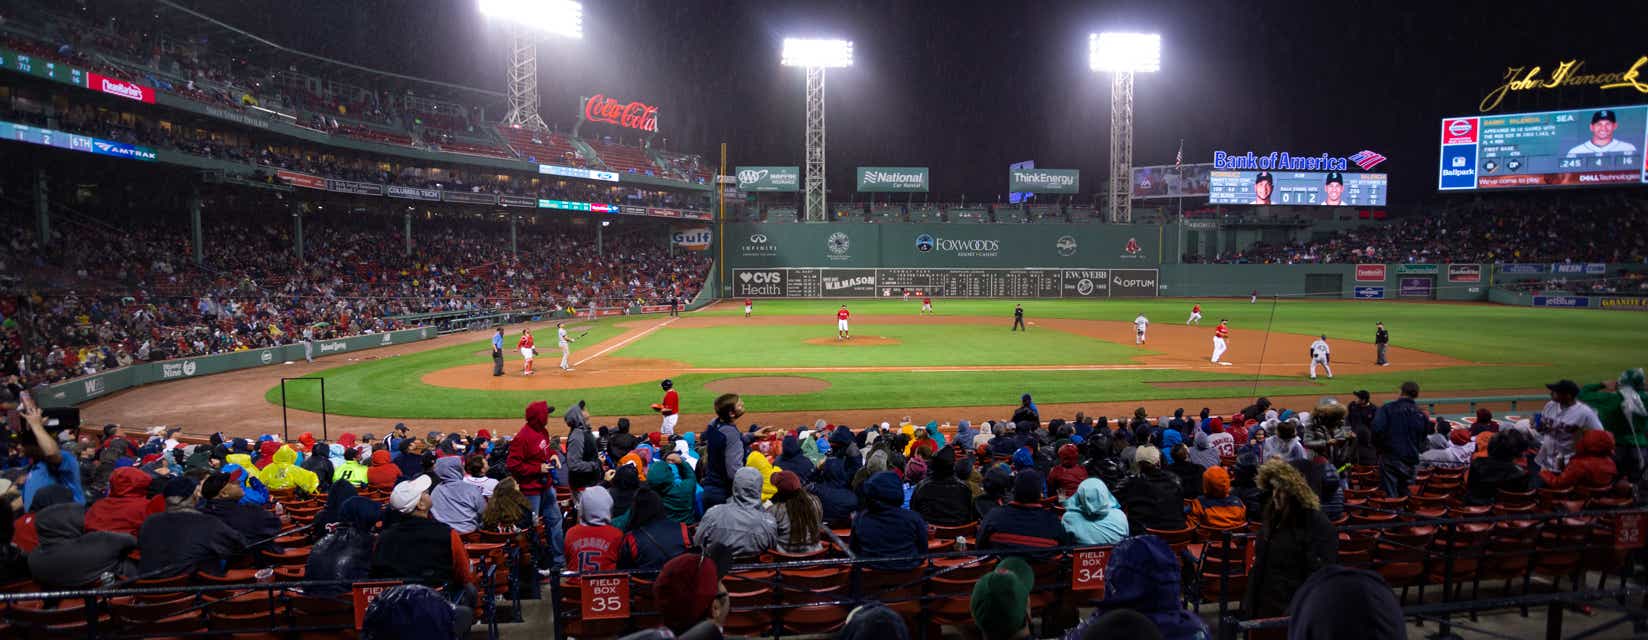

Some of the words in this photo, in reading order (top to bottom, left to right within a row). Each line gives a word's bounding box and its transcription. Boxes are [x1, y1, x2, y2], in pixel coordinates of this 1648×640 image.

[1479, 66, 1544, 112] John
[1544, 57, 1648, 94] Hancock
[585, 94, 658, 132] Coca-Cola
[73, 136, 90, 148] 6TH
[112, 148, 156, 159] AMTRAK
[1214, 151, 1258, 169] Bank
[1259, 151, 1279, 169] of
[1279, 152, 1347, 171] America
[1560, 159, 1582, 167] .245
[1596, 158, 1602, 166] 4
[877, 172, 923, 183] National
[389, 186, 420, 197] COLUMBIA
[421, 189, 439, 198] TECH
[1283, 194, 1289, 202] 0
[1309, 194, 1316, 203] 2
[673, 232, 711, 243] Gulf
[936, 238, 999, 251] FOXWOODS
[753, 272, 781, 283] CVS
[1082, 271, 1107, 279] WEBB
[742, 284, 781, 295] Health
[1123, 280, 1154, 288] OPTUM
[1546, 297, 1576, 306] jetBlue
[340, 471, 352, 481] H
[1080, 551, 1105, 559] FIELD
[577, 551, 602, 573] 15
[1082, 559, 1101, 567] BOX
[1077, 567, 1105, 582] 34
[590, 578, 621, 587] FIELD
[591, 596, 621, 612] 35
